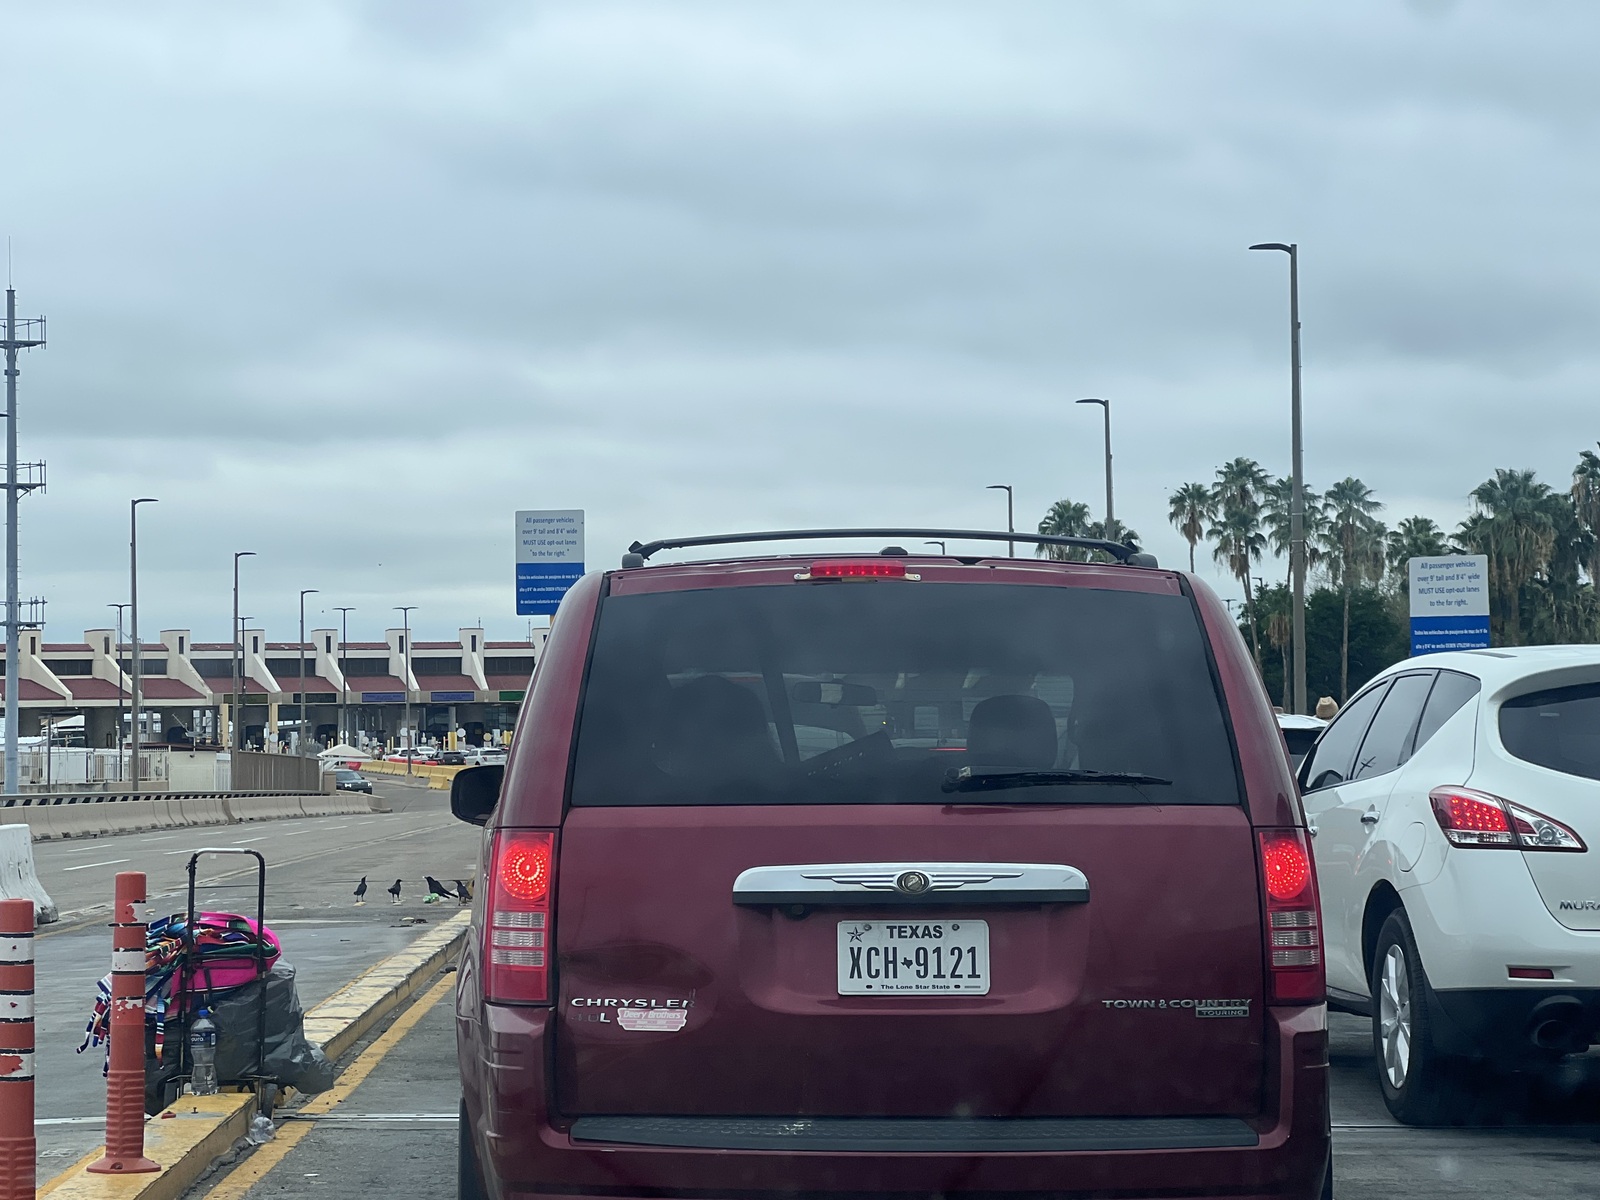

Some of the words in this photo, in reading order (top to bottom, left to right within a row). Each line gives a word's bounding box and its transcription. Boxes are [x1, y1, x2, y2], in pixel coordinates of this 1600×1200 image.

[547, 539, 564, 547] opt-out
[1420, 562, 1428, 570] All
[1429, 562, 1455, 570] passenger
[1446, 586, 1466, 594] opt-out
[1454, 599, 1469, 607] right.
[1560, 900, 1600, 911] MUR
[886, 925, 943, 939] TEXAS
[849, 946, 898, 979] XCH
[915, 946, 981, 979] 9121
[1102, 999, 1156, 1009] TOWN
[1158, 999, 1167, 1009] &
[1169, 999, 1252, 1008] COUNTRY
[623, 1010, 648, 1019] Deery
[648, 1010, 681, 1019] Brothers
